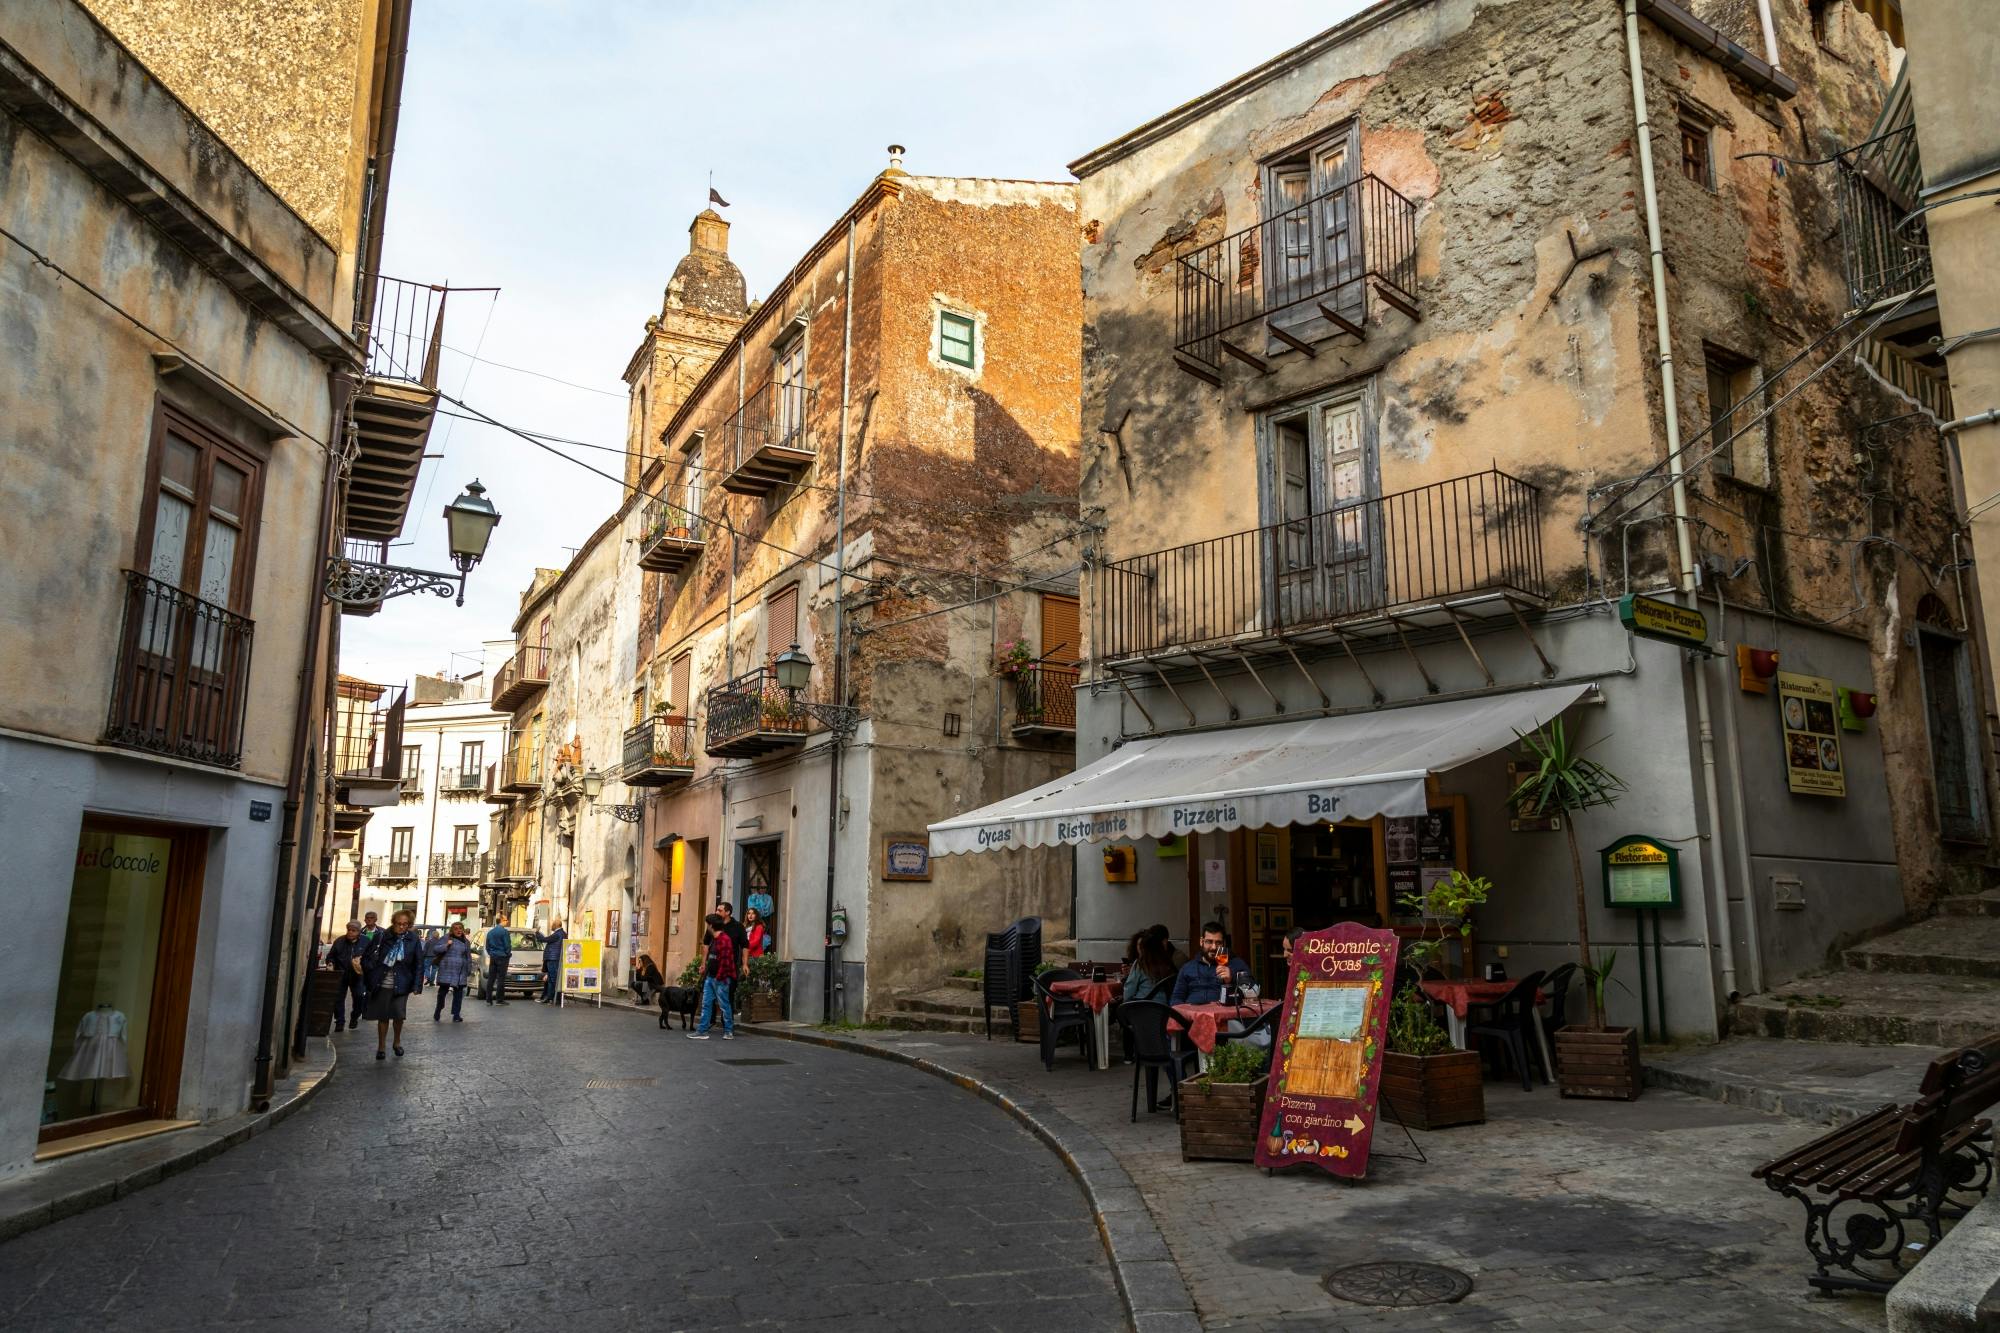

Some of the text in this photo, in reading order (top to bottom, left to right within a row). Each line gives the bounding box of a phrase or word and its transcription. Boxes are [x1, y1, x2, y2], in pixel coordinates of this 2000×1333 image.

[1635, 599, 1702, 630] Ristorante Pizzeria
[1780, 680, 1816, 694] Ristorante
[978, 794, 1340, 847] Cycas Ristorante Pizzeria Bar
[100, 847, 160, 873] Coccole
[1615, 852, 1663, 863] Ristorante
[1308, 938, 1381, 954] Ristorante
[1321, 955, 1362, 977] Cycas
[1280, 1096, 1317, 1111] Pizzeria
[1285, 1113, 1342, 1129] con giardino
